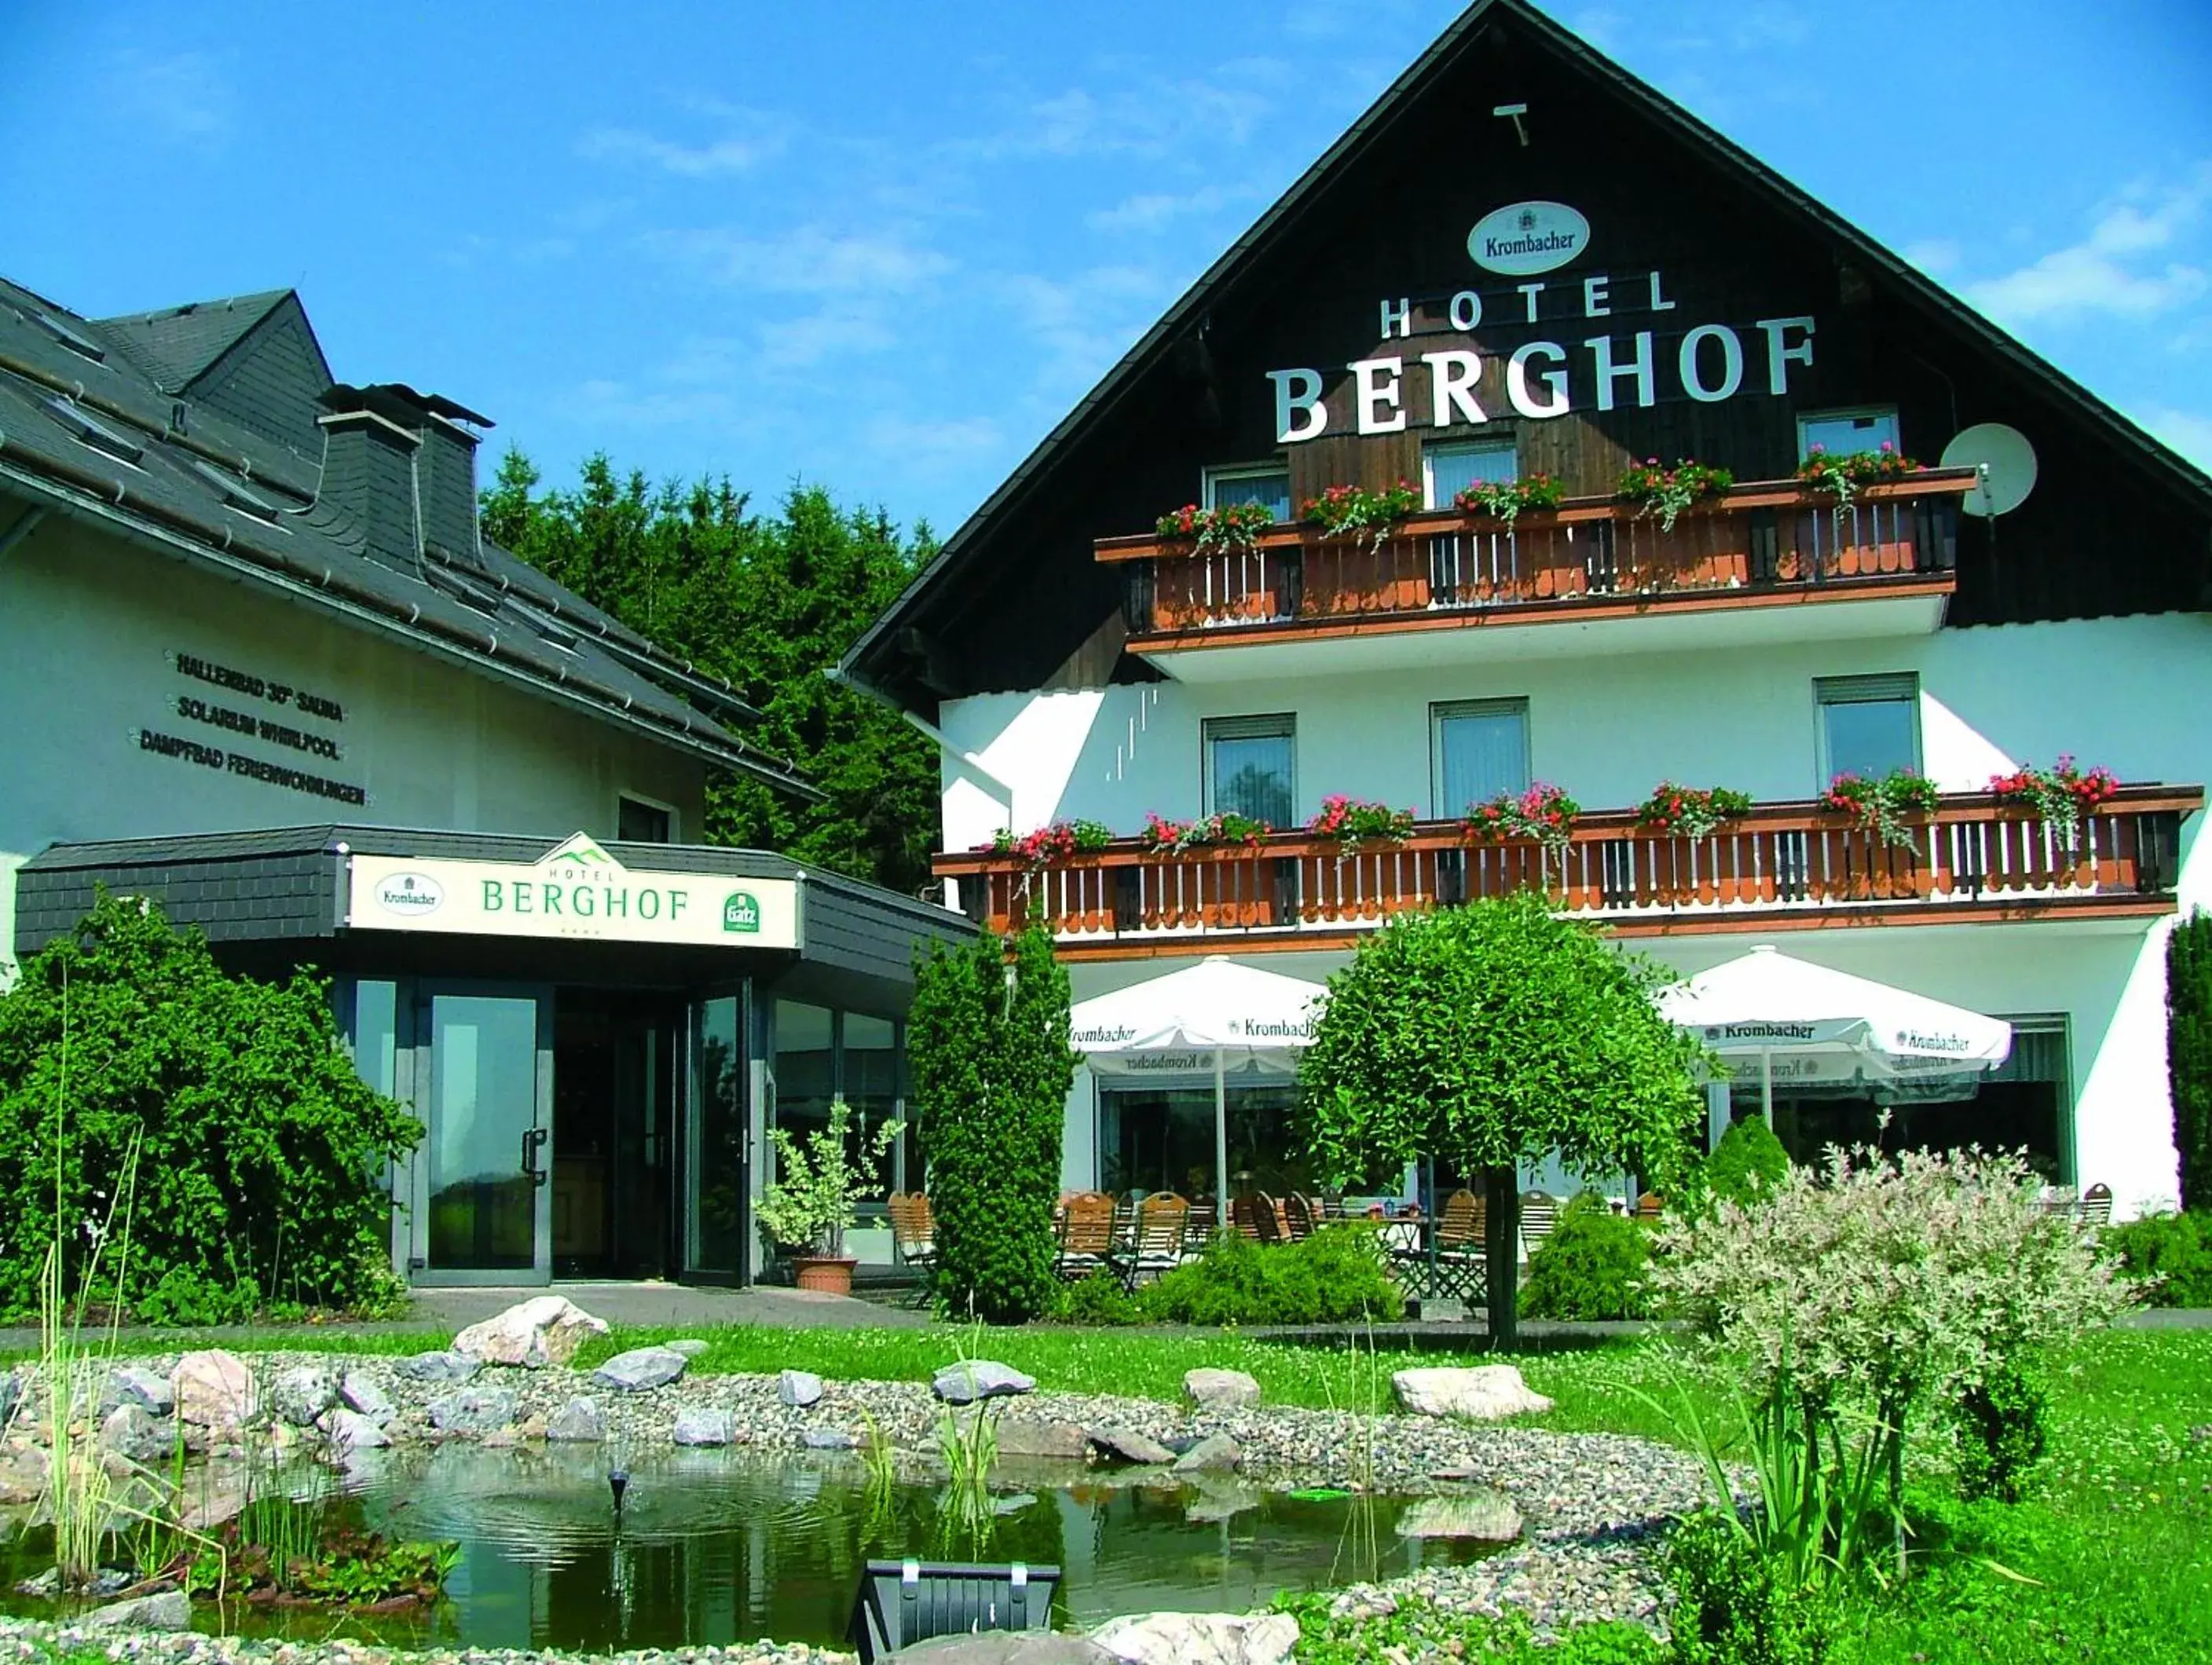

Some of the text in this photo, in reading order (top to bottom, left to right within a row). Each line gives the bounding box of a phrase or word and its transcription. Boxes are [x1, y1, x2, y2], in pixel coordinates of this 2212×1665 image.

[1486, 231, 1575, 257] Krombacher
[1380, 271, 1675, 339] HOTEL
[1265, 316, 1815, 444] BERGHOF
[177, 653, 265, 697] HALLENBAD
[297, 692, 342, 722] SAUNA
[178, 697, 340, 760] SOLARIUM WHIRLPOOL
[141, 730, 364, 805] DAMPFBAD FERIENWOHNUNGEN
[550, 869, 613, 882] HOTEL
[384, 890, 436, 905] Krombacher
[481, 880, 688, 920] BERGHOF
[1070, 1024, 1137, 1042] rombacher
[1245, 1019, 1317, 1037] Krombach
[1725, 1024, 1815, 1039] Krombacher
[1909, 1029, 1969, 1051] Krombacher
